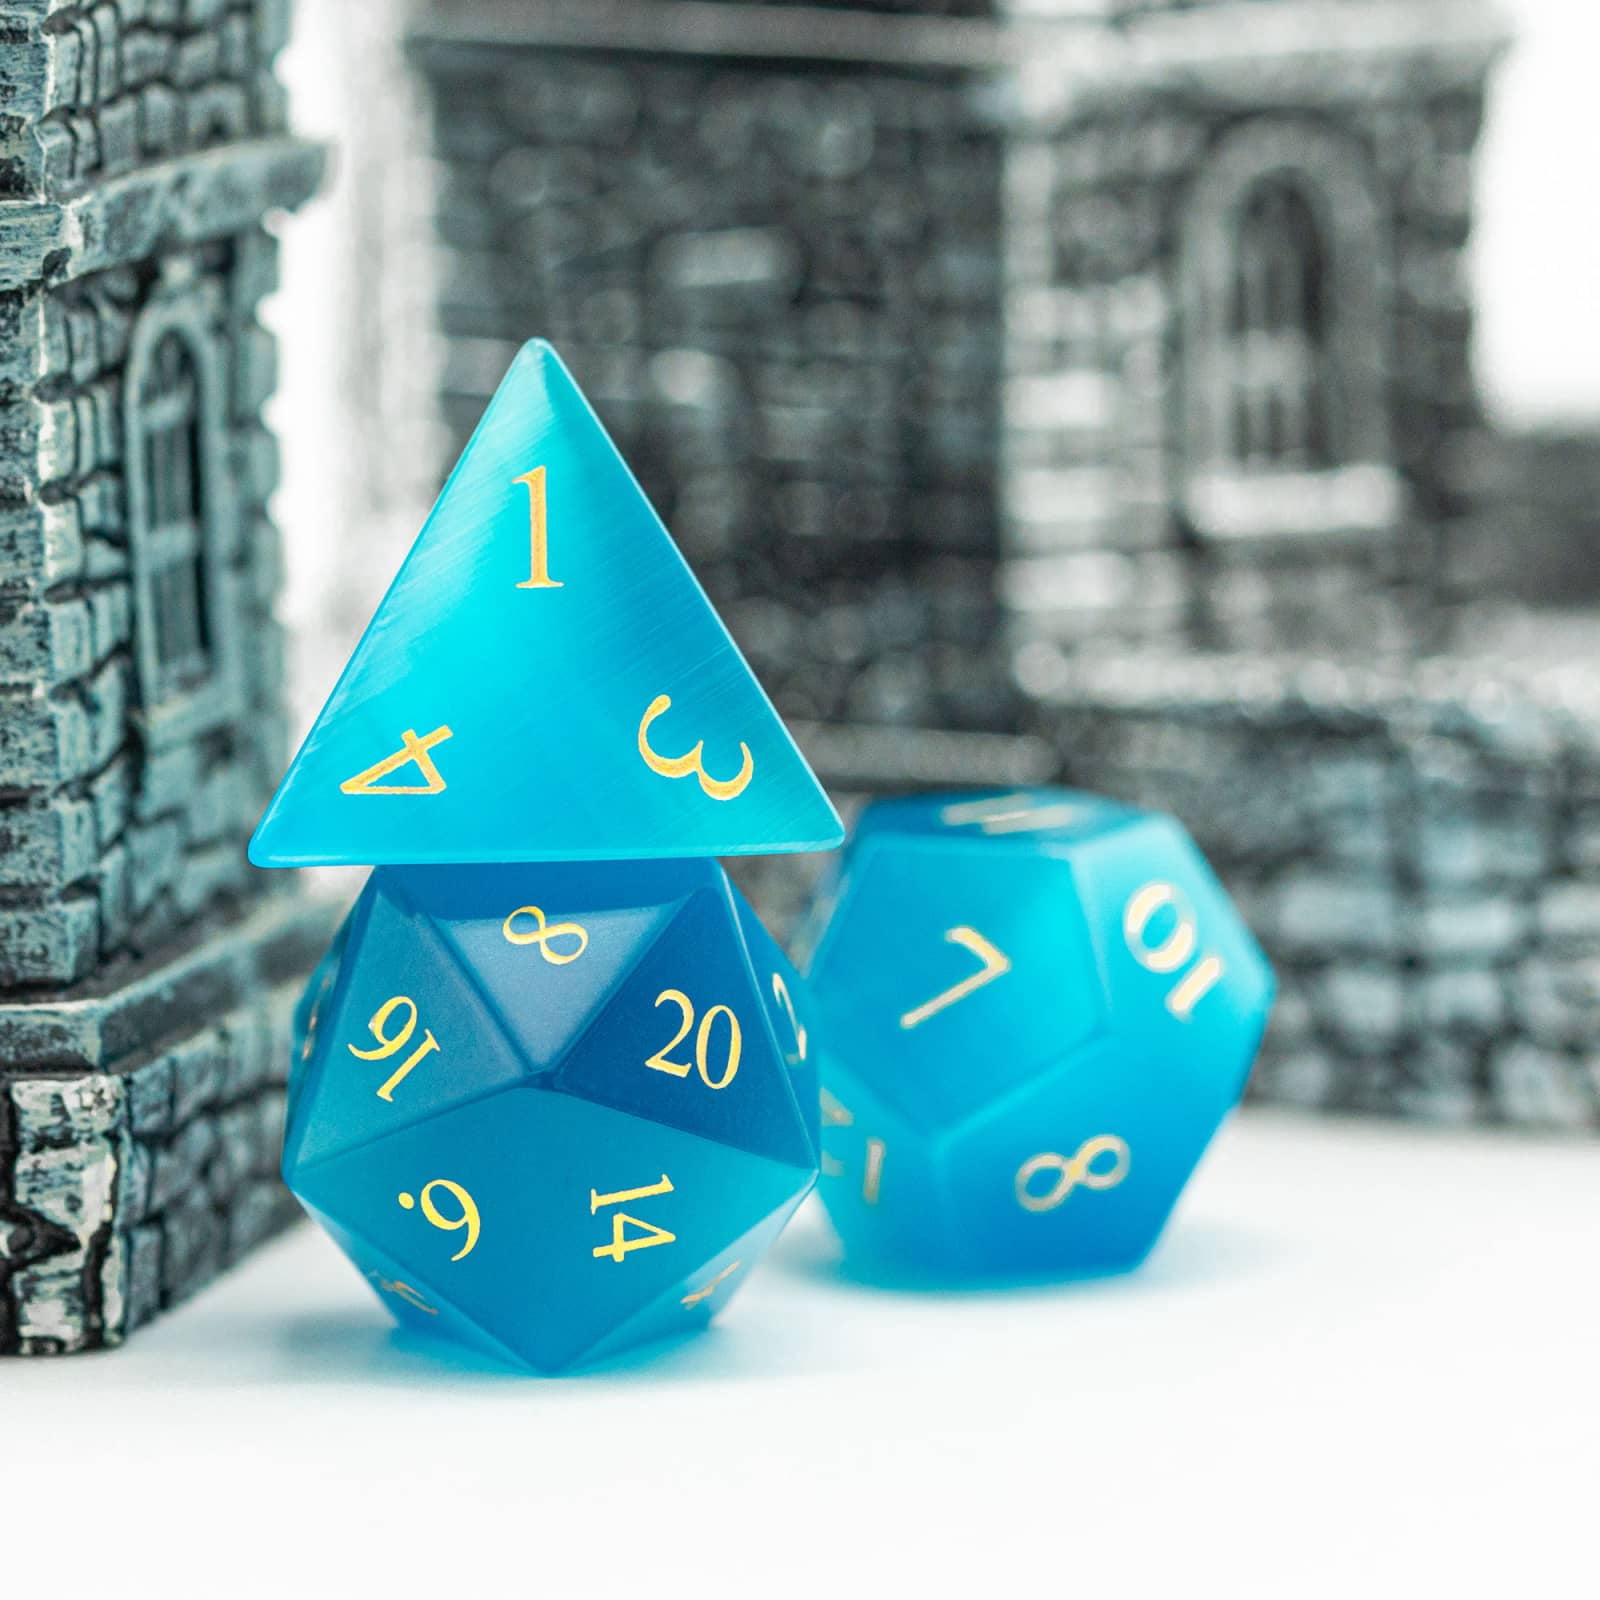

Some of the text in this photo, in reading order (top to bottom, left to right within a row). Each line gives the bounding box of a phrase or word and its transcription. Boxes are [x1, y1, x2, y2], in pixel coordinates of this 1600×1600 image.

[513, 465, 564, 589] 1
[340, 725, 454, 796] 4
[638, 695, 755, 801] 3
[502, 905, 589, 966] 8
[900, 926, 1012, 1029] 7
[1124, 880, 1224, 1022] 10
[347, 995, 442, 1103] 16
[644, 988, 743, 1090] 20
[590, 1173, 677, 1264] 14
[1014, 1132, 1132, 1213] 8
